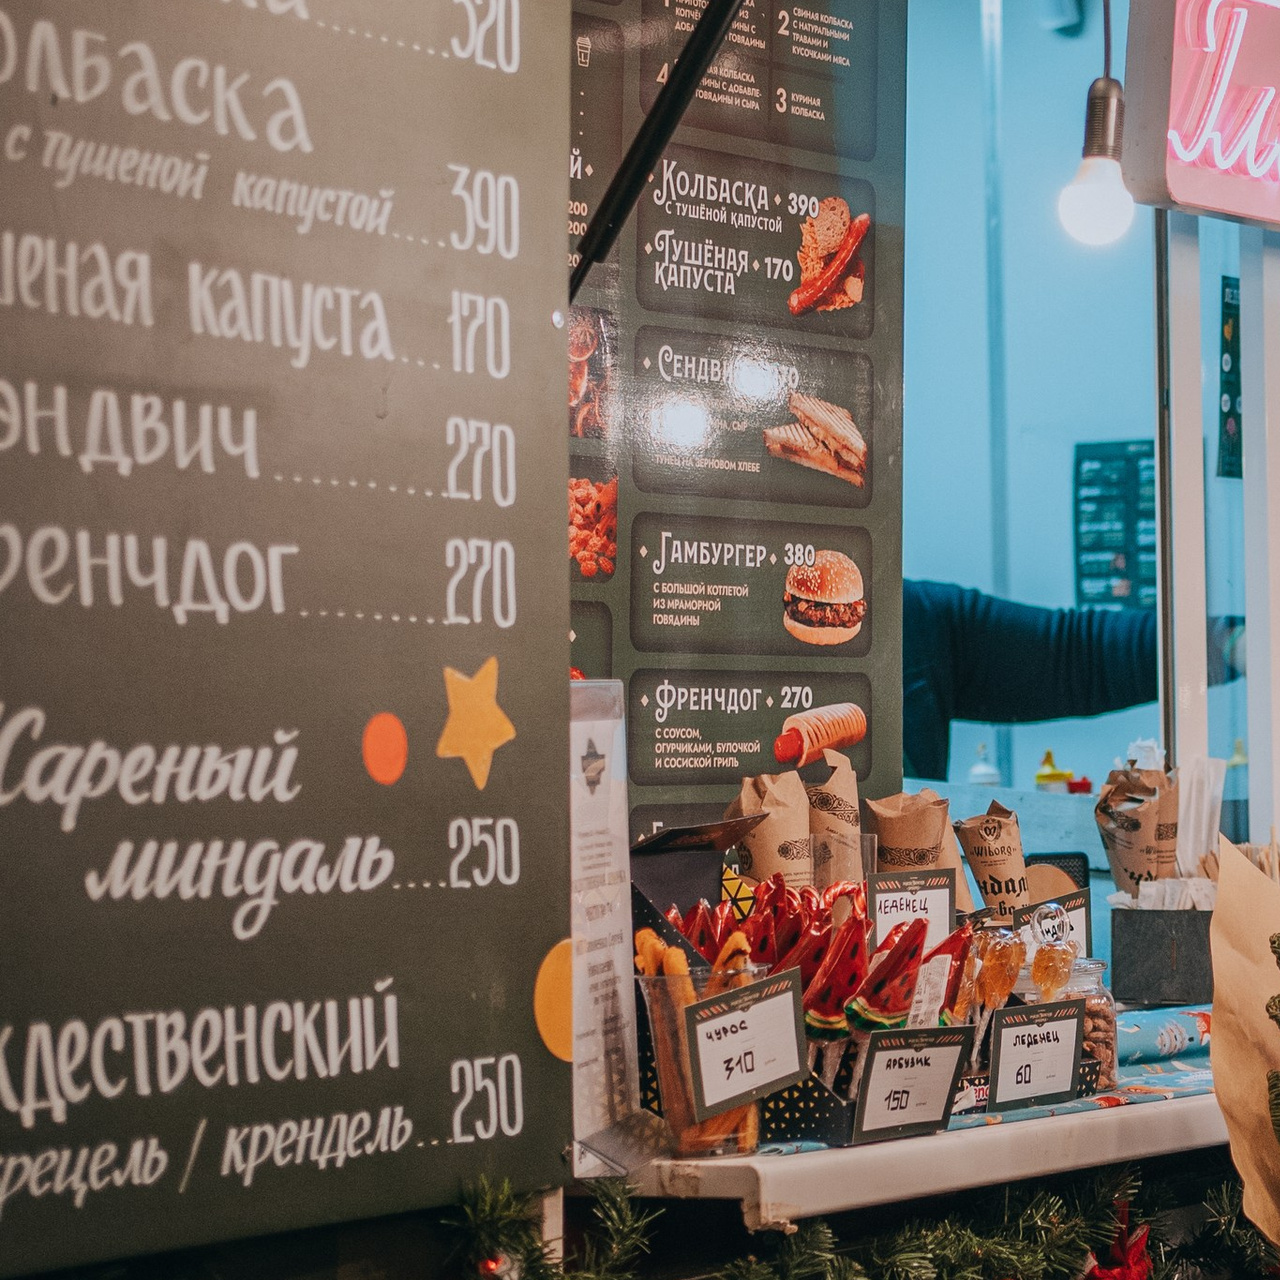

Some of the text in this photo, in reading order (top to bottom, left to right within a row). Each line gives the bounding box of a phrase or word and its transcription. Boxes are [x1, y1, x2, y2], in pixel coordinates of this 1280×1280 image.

[778, 10, 790, 36] 2
[793, 7, 854, 30] СВИНАЯ КОЛБАСКА
[728, 32, 766, 50] ГОВЯДИНЫ
[792, 32, 822, 48] ТРАВАМИ
[799, 22, 850, 41] НАТУРАЛЬНЫМИ
[792, 45, 832, 63] КУСОЧКАМИ
[719, 67, 755, 84] КОЛБАСКА
[695, 88, 734, 105] ГОВЯДИНЫ
[741, 99, 760, 111] СЫРА
[775, 87, 787, 113] 3
[791, 92, 821, 107] КУРИНАЯ
[791, 105, 825, 121] КОЛБАСКА
[653, 158, 820, 219] КОЛБАСКА 390
[448, 163, 520, 260] 390
[665, 201, 783, 234] С ТУШЁНОЙ КАПУСТОЙ
[654, 229, 794, 282] ТУШЁНАЯ 170
[654, 261, 736, 296] КАПУСТА
[448, 289, 511, 379] 170
[658, 344, 728, 384] СЕНДВ
[445, 416, 518, 508] 270
[696, 458, 737, 471] ЗЕРНОВОМ
[737, 461, 761, 472] ХЛЕБЕ
[652, 531, 816, 575] ГАМБУРГЕР 380
[445, 538, 518, 628] 270
[653, 582, 749, 597] С БОЛЬШОЙ КОТЛЕТОЙ
[653, 598, 721, 611] ИЗ МРАМОРНОЙ
[652, 613, 700, 627] ГОВЯДИНЫ
[655, 679, 813, 723] ФРЕНЧДОГ 270
[655, 728, 702, 741] С СОУСОМ,
[655, 739, 760, 755] ОГУРЧИКАМИ, БУЛОЧКОЙ
[655, 754, 739, 768] И СОСИСКОЙ ГРИЛЬ
[84, 834, 395, 941] миндаль
[447, 817, 520, 890] 250
[878, 897, 929, 915] ЛЕДЕНЕЦ
[1013, 1031, 1060, 1048] ЛЕДЕНЕЦ
[723, 1051, 755, 1080] 310
[886, 1056, 931, 1070] АРБУЗИК
[1016, 1064, 1031, 1084] 60
[885, 1089, 910, 1111] 150
[220, 1106, 413, 1187] крендель
[450, 1053, 523, 1144] 250
